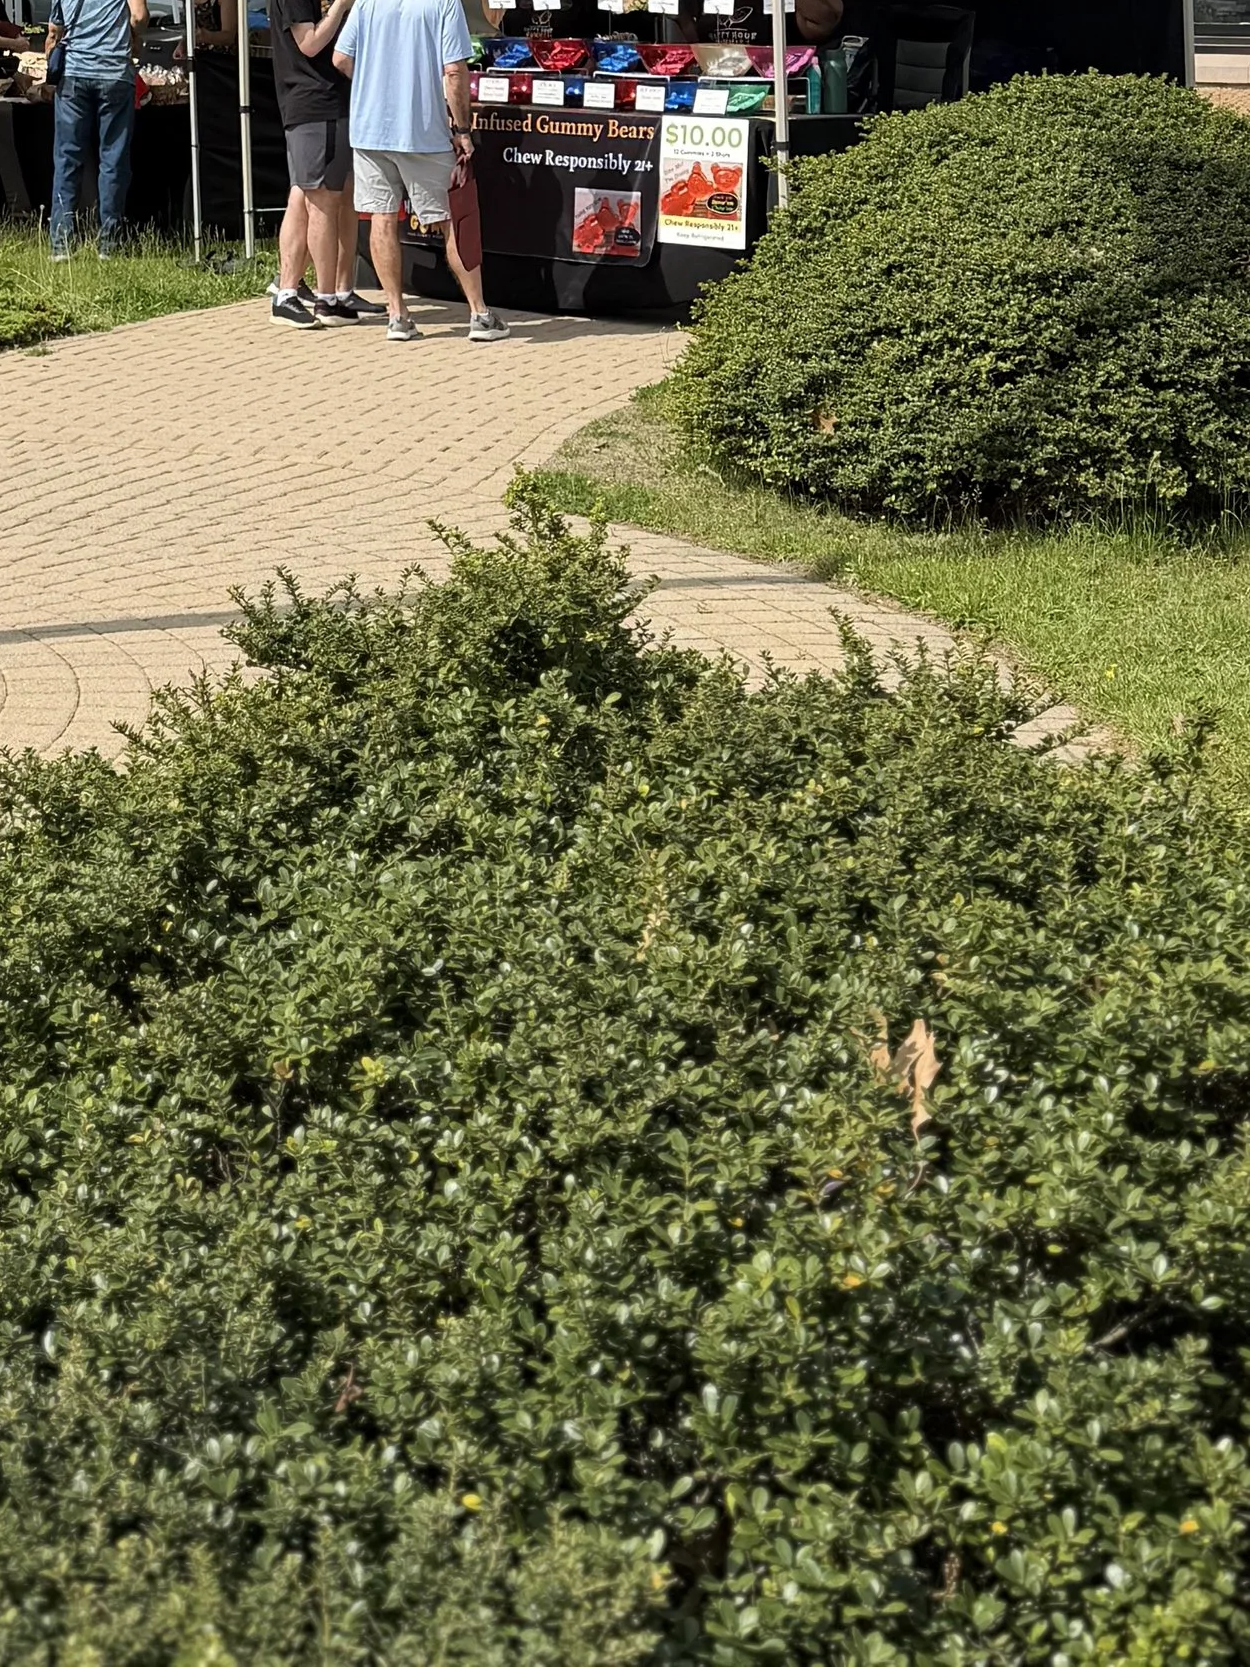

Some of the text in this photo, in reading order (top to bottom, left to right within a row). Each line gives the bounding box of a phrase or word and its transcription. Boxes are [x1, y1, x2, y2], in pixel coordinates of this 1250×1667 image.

[470, 112, 532, 133] Infused
[536, 115, 604, 142] Gummy
[607, 119, 655, 140] Bears
[665, 123, 743, 149] $10.00
[503, 147, 543, 166] Chew
[545, 149, 632, 175] Responsibly
[634, 159, 654, 173] 21+
[664, 218, 683, 227] Chew
